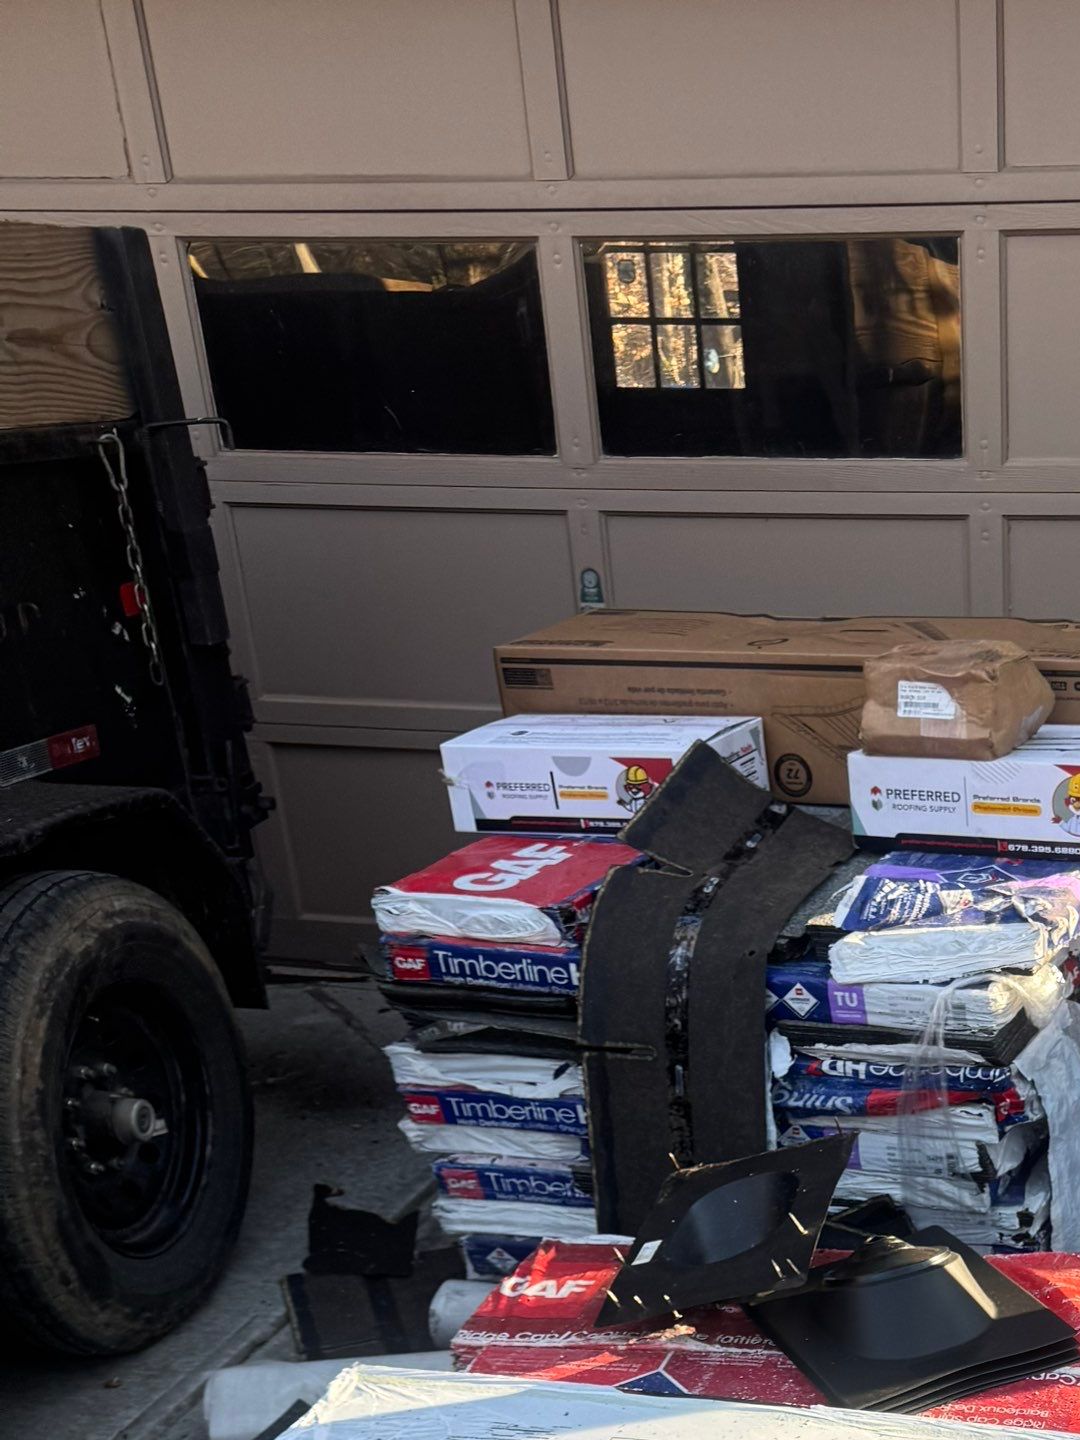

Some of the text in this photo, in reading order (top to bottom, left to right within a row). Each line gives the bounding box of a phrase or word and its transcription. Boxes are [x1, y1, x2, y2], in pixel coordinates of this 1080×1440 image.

[496, 782, 550, 792] PREFERRED
[886, 788, 961, 803] PREFERRED
[892, 804, 957, 813] ROOFING SUPPLY
[453, 843, 574, 892] GAF
[394, 957, 426, 970] GAF
[833, 991, 858, 1008] TU
[408, 1103, 440, 1115] GAF
[500, 1276, 596, 1299] GAF
[455, 1329, 510, 1342] Ridge
[979, 1405, 1050, 1418] Bardeaux
[966, 1414, 1046, 1430] Ridge Cap
